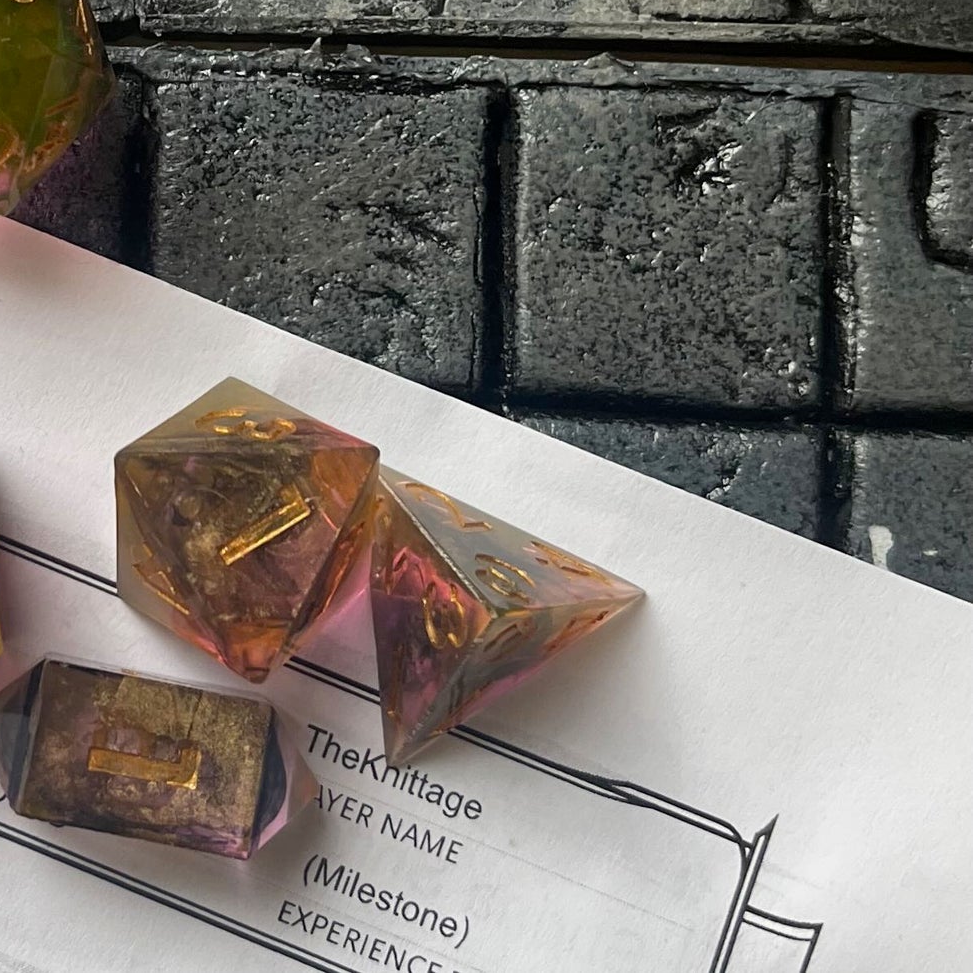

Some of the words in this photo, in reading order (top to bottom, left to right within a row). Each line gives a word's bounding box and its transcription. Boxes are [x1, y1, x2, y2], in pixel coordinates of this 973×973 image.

[308, 724, 483, 820] TheKnittage
[380, 813, 464, 864] NAME
[304, 854, 469, 949] (Milestone)
